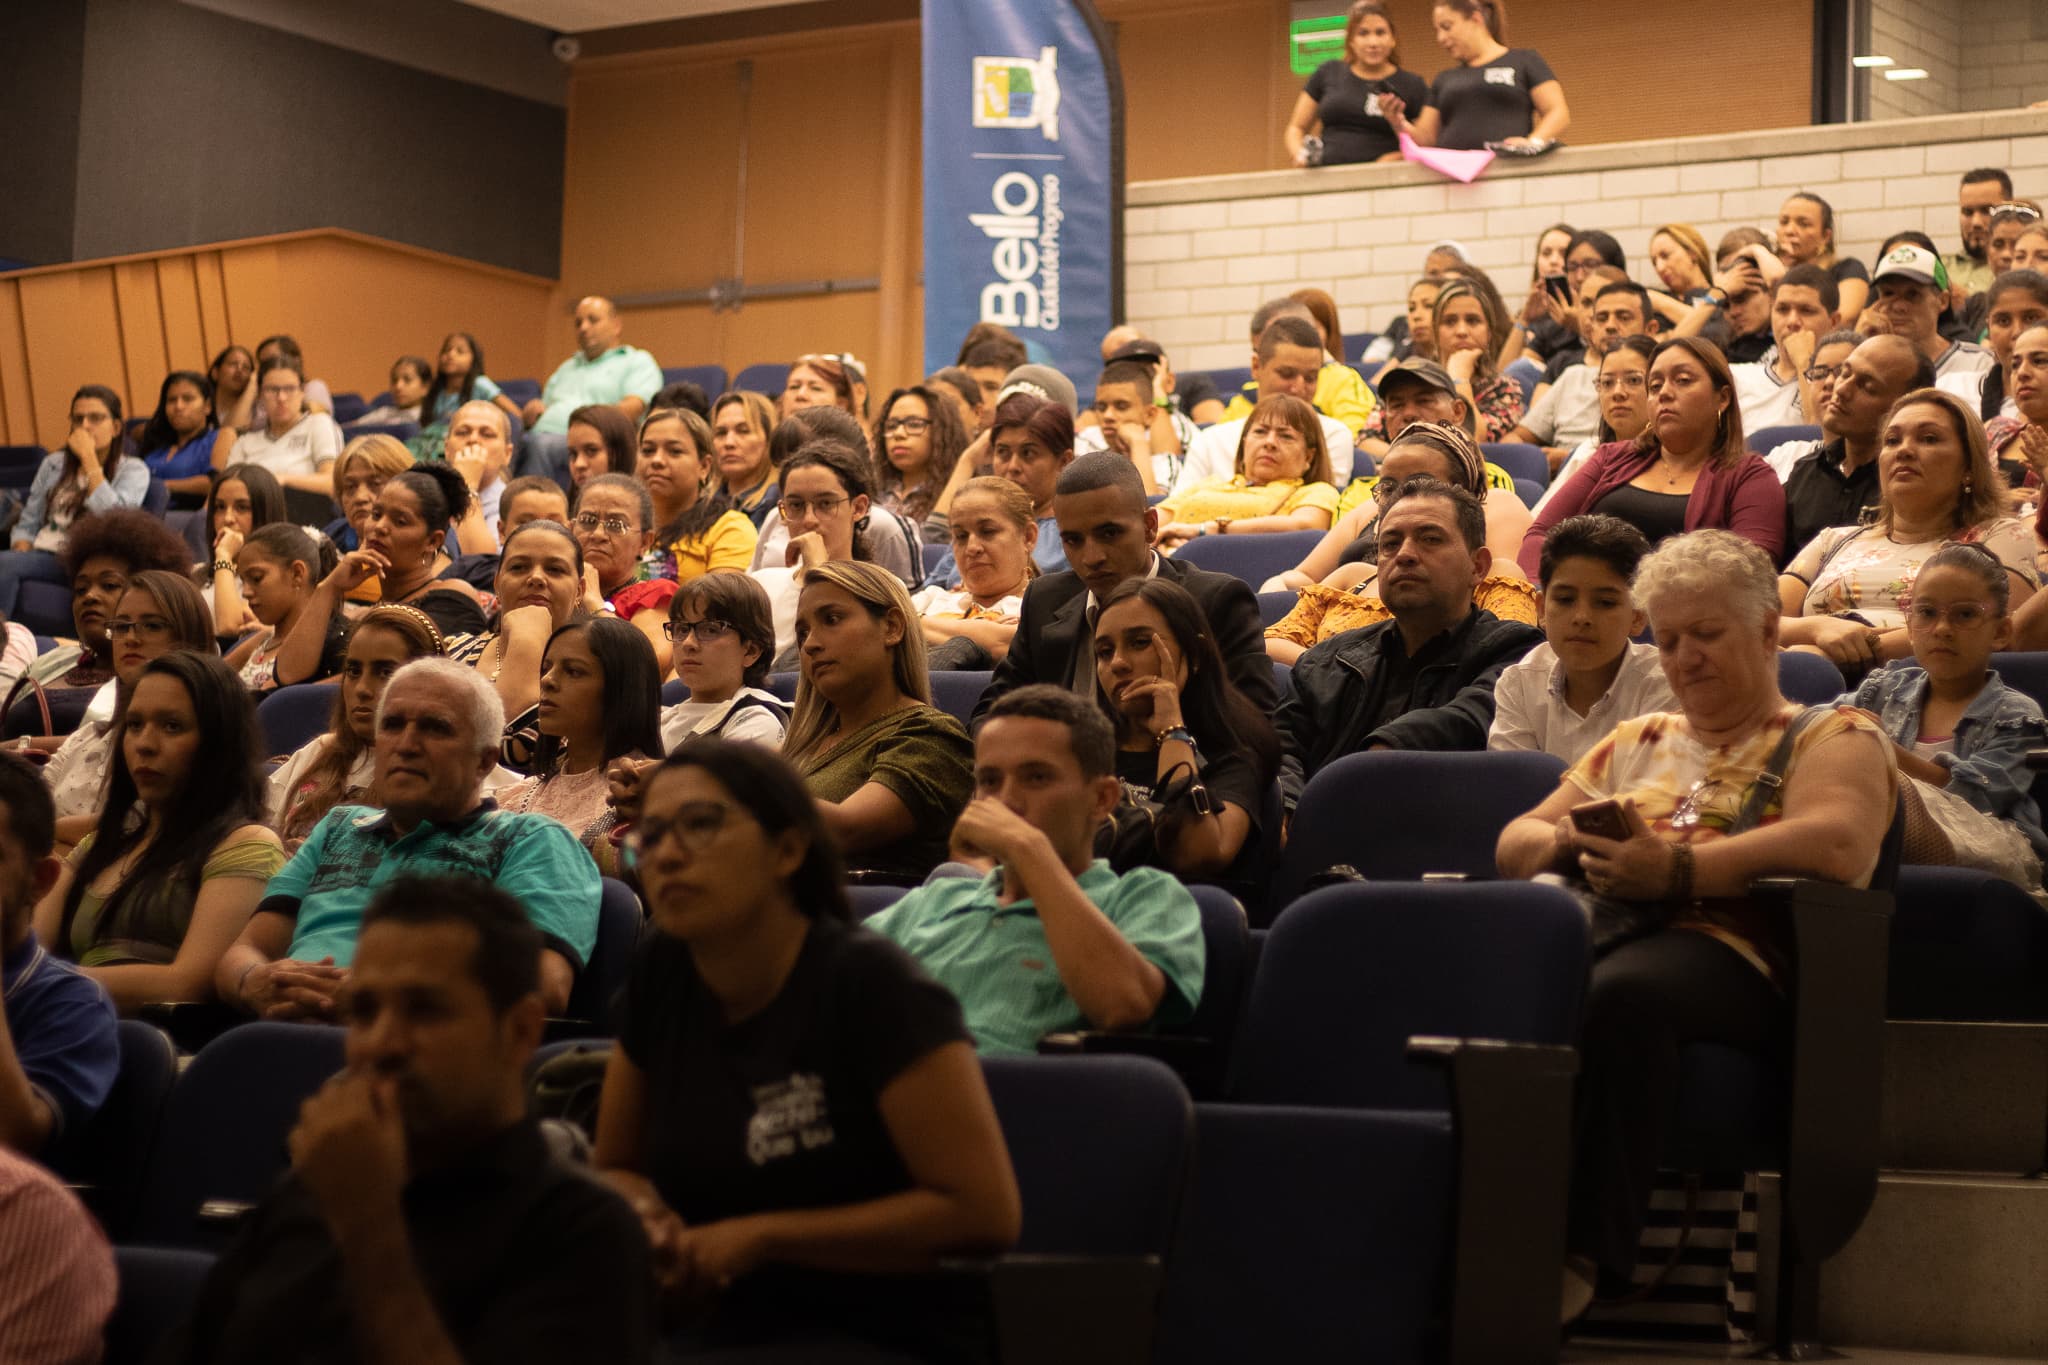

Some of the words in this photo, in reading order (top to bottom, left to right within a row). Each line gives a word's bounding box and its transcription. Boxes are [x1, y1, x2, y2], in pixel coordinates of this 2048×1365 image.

[1041, 174, 1064, 248] Progreso
[968, 172, 1039, 327] Bello
[1040, 249, 1060, 269] de
[1040, 269, 1060, 330] Ciudad
